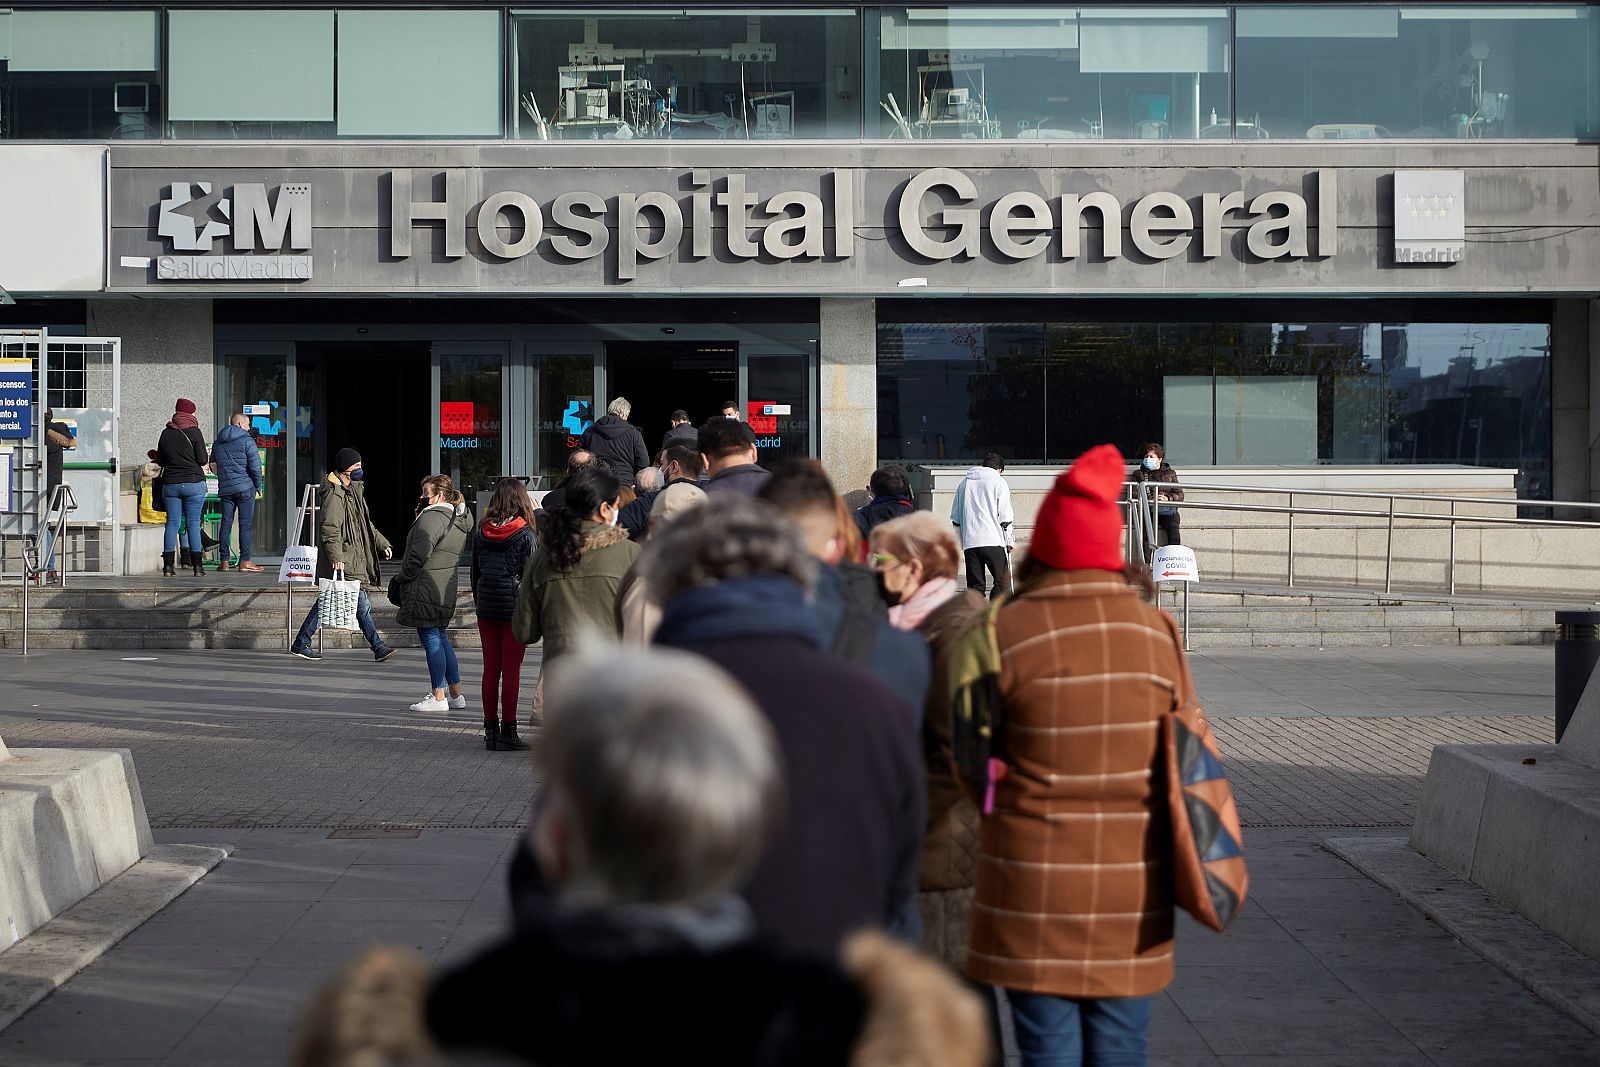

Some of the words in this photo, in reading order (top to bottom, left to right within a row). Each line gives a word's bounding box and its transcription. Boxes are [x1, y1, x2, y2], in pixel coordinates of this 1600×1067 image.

[391, 169, 854, 279] Hospital
[898, 168, 1337, 259] General
[1395, 247, 1464, 263] Madrid
[158, 256, 310, 279] SaludMadrid
[5, 398, 15, 406] los
[16, 398, 28, 406] dos
[440, 437, 478, 448] Madrid
[755, 436, 781, 448] adrid
[289, 563, 311, 571] COVID
